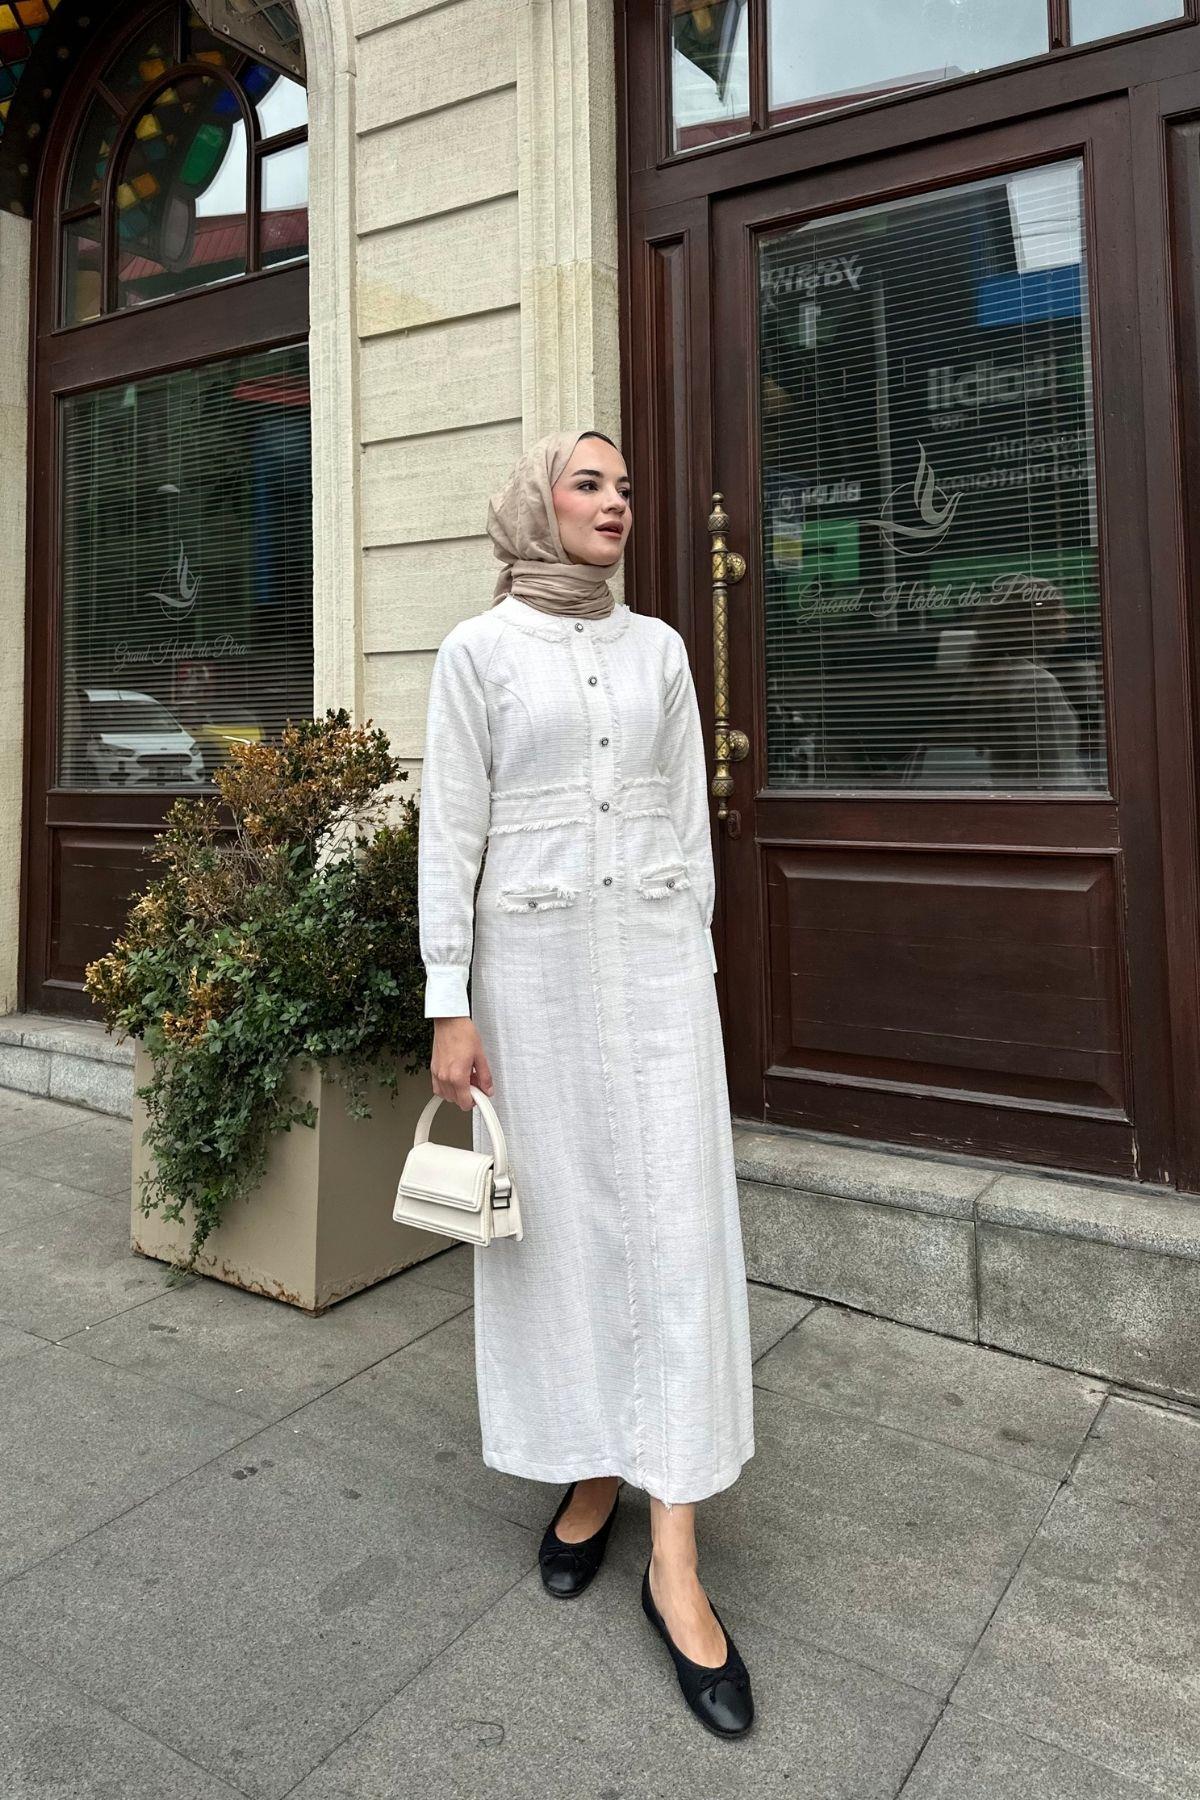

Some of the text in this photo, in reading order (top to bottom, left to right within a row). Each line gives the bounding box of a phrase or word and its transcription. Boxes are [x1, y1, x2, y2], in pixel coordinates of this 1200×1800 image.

[797, 572, 1057, 623] Grand Hotel de Pera
[113, 632, 249, 673] Grand Hotel de Pera
